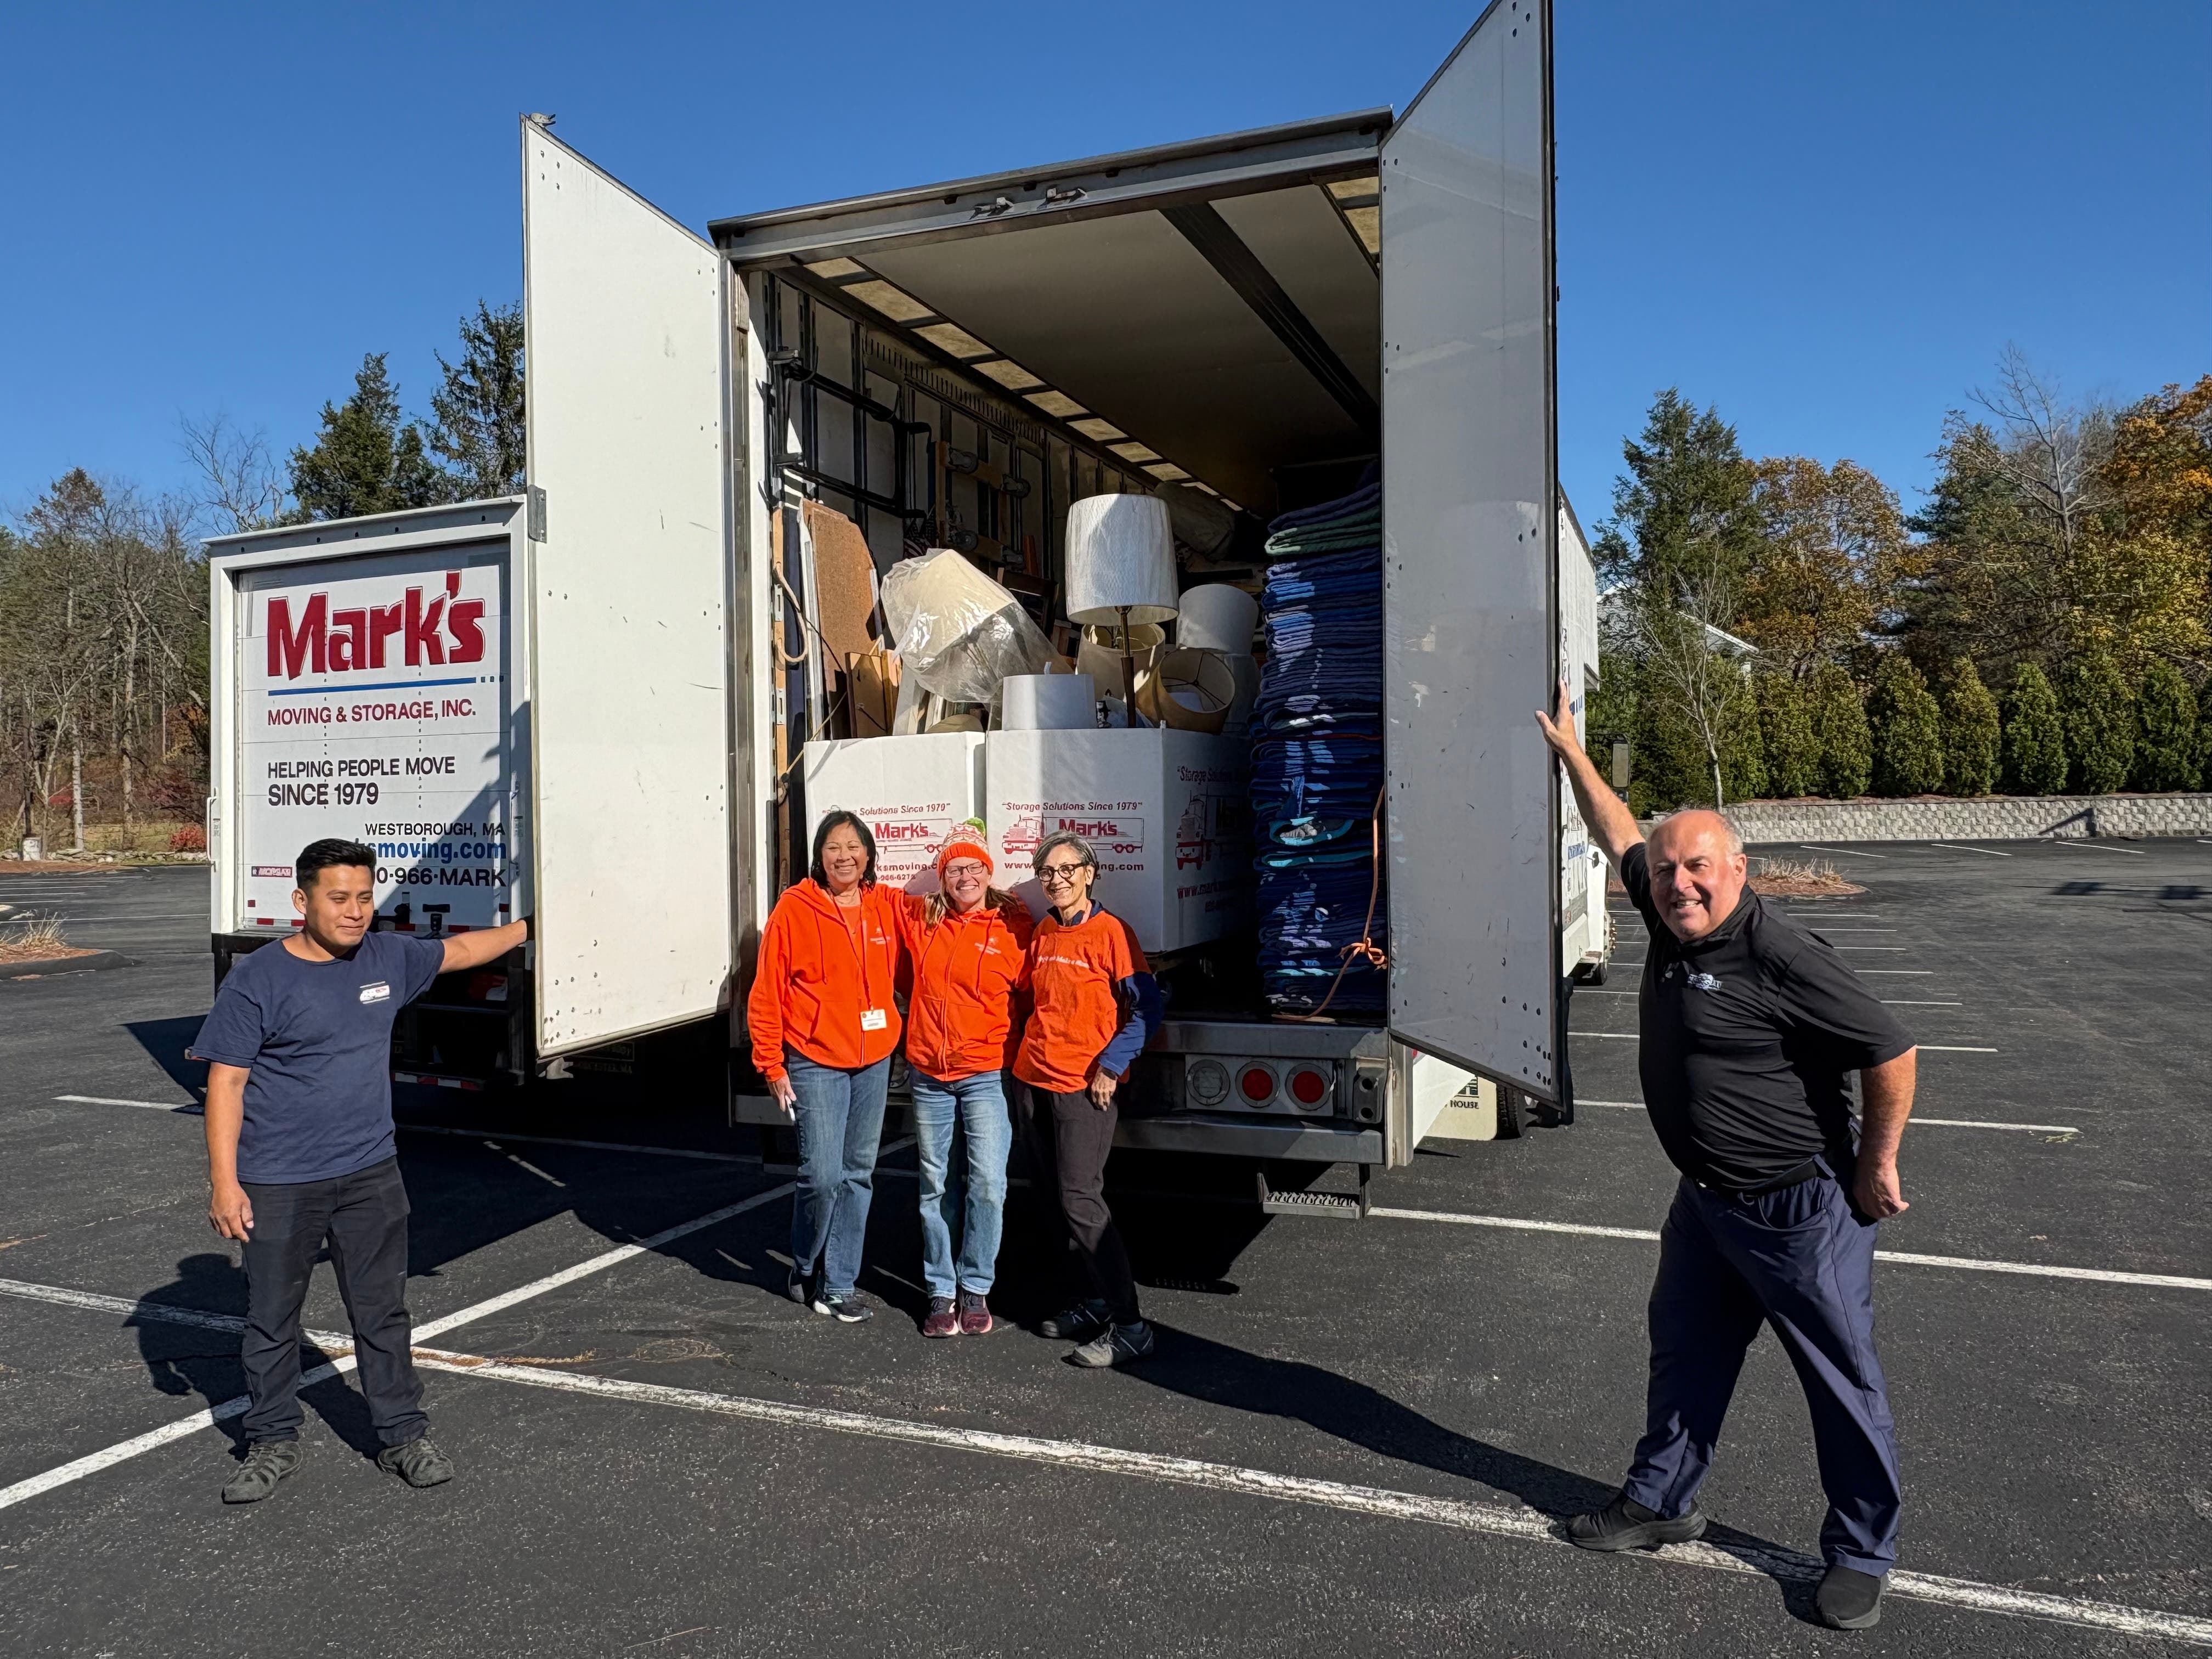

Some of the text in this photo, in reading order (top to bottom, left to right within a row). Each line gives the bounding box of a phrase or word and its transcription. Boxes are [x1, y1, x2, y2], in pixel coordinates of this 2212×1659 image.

[267, 569, 486, 680] Mark's
[268, 698, 477, 726] MOVING & STORAGE, INC.
[268, 756, 456, 779] HELPING PEOPLE MOVE
[268, 782, 380, 806] SINCE 1979
[859, 806, 899, 816] Solutions
[900, 804, 924, 814] Since
[1042, 802, 1085, 811] Solutions
[1087, 802, 1114, 811] Since
[365, 822, 477, 838] WESTBOROUGH,
[482, 822, 506, 836] MA
[874, 822, 929, 839] Mark's
[1059, 819, 1118, 836] Mark's
[356, 837, 507, 864] smoving.com
[876, 862, 938, 872] ksmoving.c
